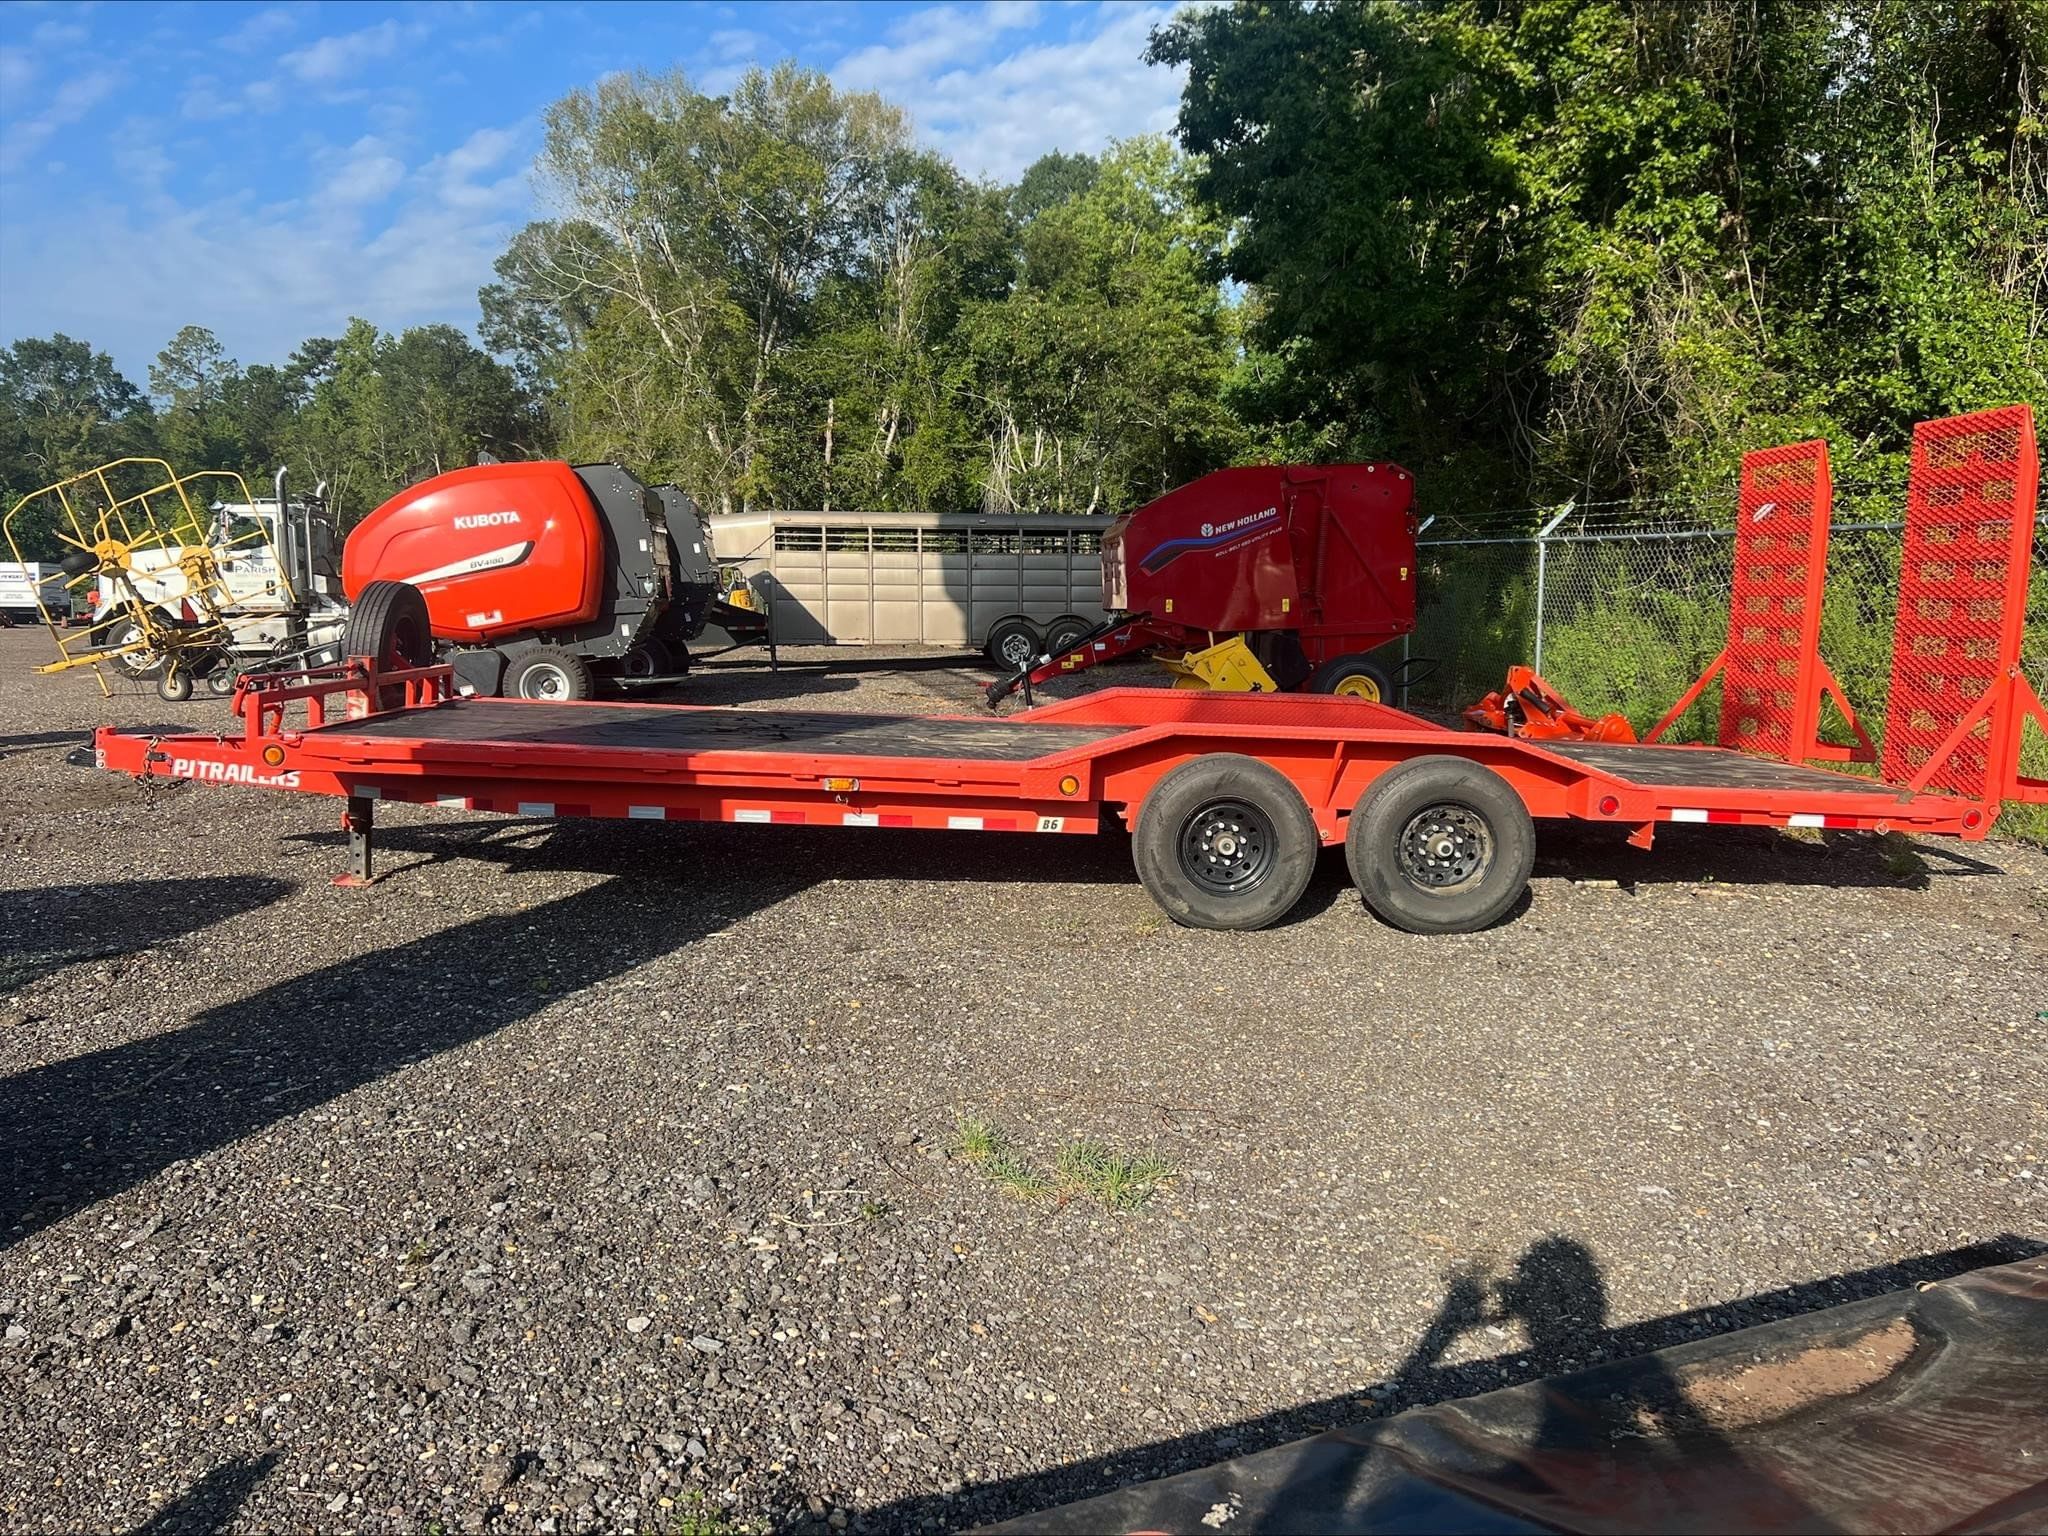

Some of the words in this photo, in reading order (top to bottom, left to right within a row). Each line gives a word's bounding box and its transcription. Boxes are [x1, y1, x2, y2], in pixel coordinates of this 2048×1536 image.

[453, 511, 521, 529] KUBOTA
[1215, 521, 1235, 535] NEW
[1237, 507, 1277, 527] HOLLAND
[234, 565, 276, 574] PARISH
[173, 758, 195, 778] PJ
[1042, 819, 1059, 830] B6
